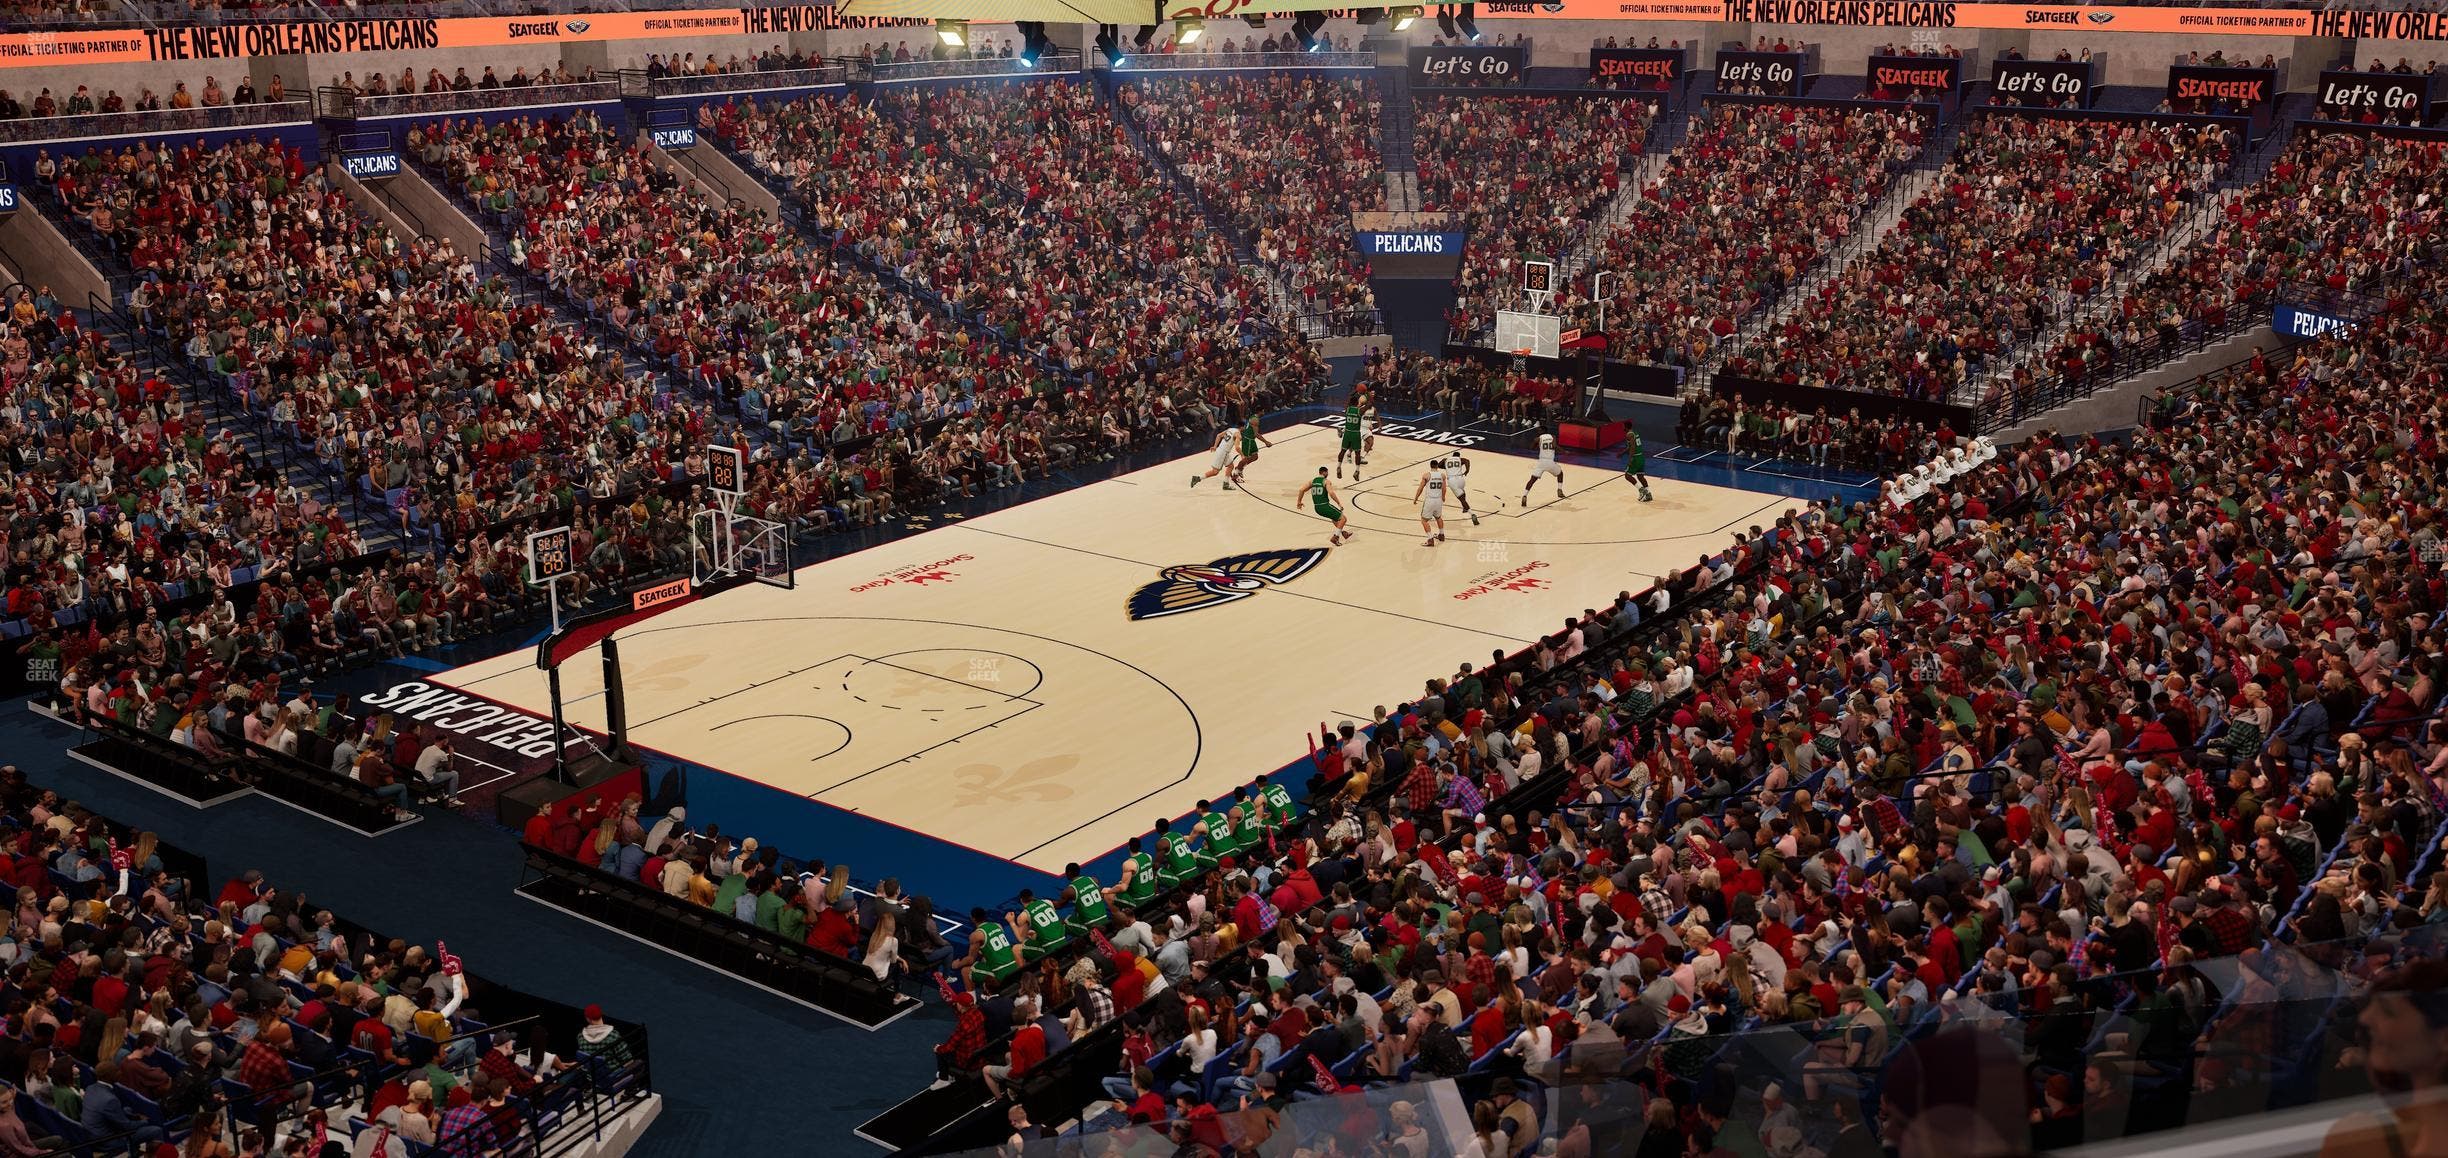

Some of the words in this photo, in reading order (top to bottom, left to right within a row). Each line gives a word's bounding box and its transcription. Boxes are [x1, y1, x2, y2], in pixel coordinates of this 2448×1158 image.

[1488, 2, 1534, 14] SEATGEEK
[1620, 4, 1648, 14] OFFICIAL
[1650, 5, 1684, 14] TICKETING
[1684, 5, 1712, 14] PARTNER
[1713, 6, 1721, 14] OF
[1724, 0, 1750, 22] THE
[1754, 1, 1793, 24] NEW
[1794, 1, 1870, 26] ORLEANS
[1873, 1, 1956, 28] PELICANS
[2025, 10, 2080, 25] SEATGEEK
[508, 20, 560, 38] SEATGEEK
[644, 19, 672, 30] OFFICIAL
[674, 18, 704, 29] TICKETING
[705, 16, 731, 28] PARTNER
[732, 16, 740, 26] OF
[741, 8, 768, 34] THE
[770, 7, 802, 32] NEW
[2180, 15, 2214, 26] OFFICIAL
[2216, 16, 2257, 27] TICKETING
[2258, 17, 2294, 27] PARTNER
[2296, 18, 2306, 28] OF
[2310, 10, 2346, 38] THE
[2350, 11, 2392, 39] NEW
[0, 44, 34, 56] FICIAL
[35, 41, 86, 56] TICKETING
[88, 40, 128, 53] PARTNER
[130, 40, 142, 52] OF
[144, 28, 188, 61] THE
[191, 26, 240, 58] NEW
[246, 22, 342, 56] ORLEANS
[345, 20, 438, 52] PELICANS
[1422, 56, 1472, 74] Let's
[1478, 56, 1510, 75] Go
[1600, 58, 1674, 78] SEATGEEK
[1720, 61, 1762, 82] Let's
[1767, 62, 1794, 82] Go
[1876, 66, 1950, 88] SEATGEEK
[1997, 70, 2046, 92] Let's
[2052, 72, 2082, 94] Go
[2178, 77, 2264, 101] SEATGEEK
[2324, 82, 2378, 108] Let's
[2384, 86, 2418, 110] Go
[1375, 234, 1443, 252] PELICANS
[894, 552, 975, 580] SMOOTHIE
[639, 582, 686, 606] SEATGEEK
[360, 682, 593, 759] PELICANS
[1270, 790, 1292, 808] 00
[1211, 824, 1230, 840] 00
[1174, 842, 1192, 858] 00
[1140, 868, 1154, 884] 00
[1080, 889, 1102, 908] 00
[1034, 908, 1060, 928] 00
[990, 934, 1010, 952] 00
